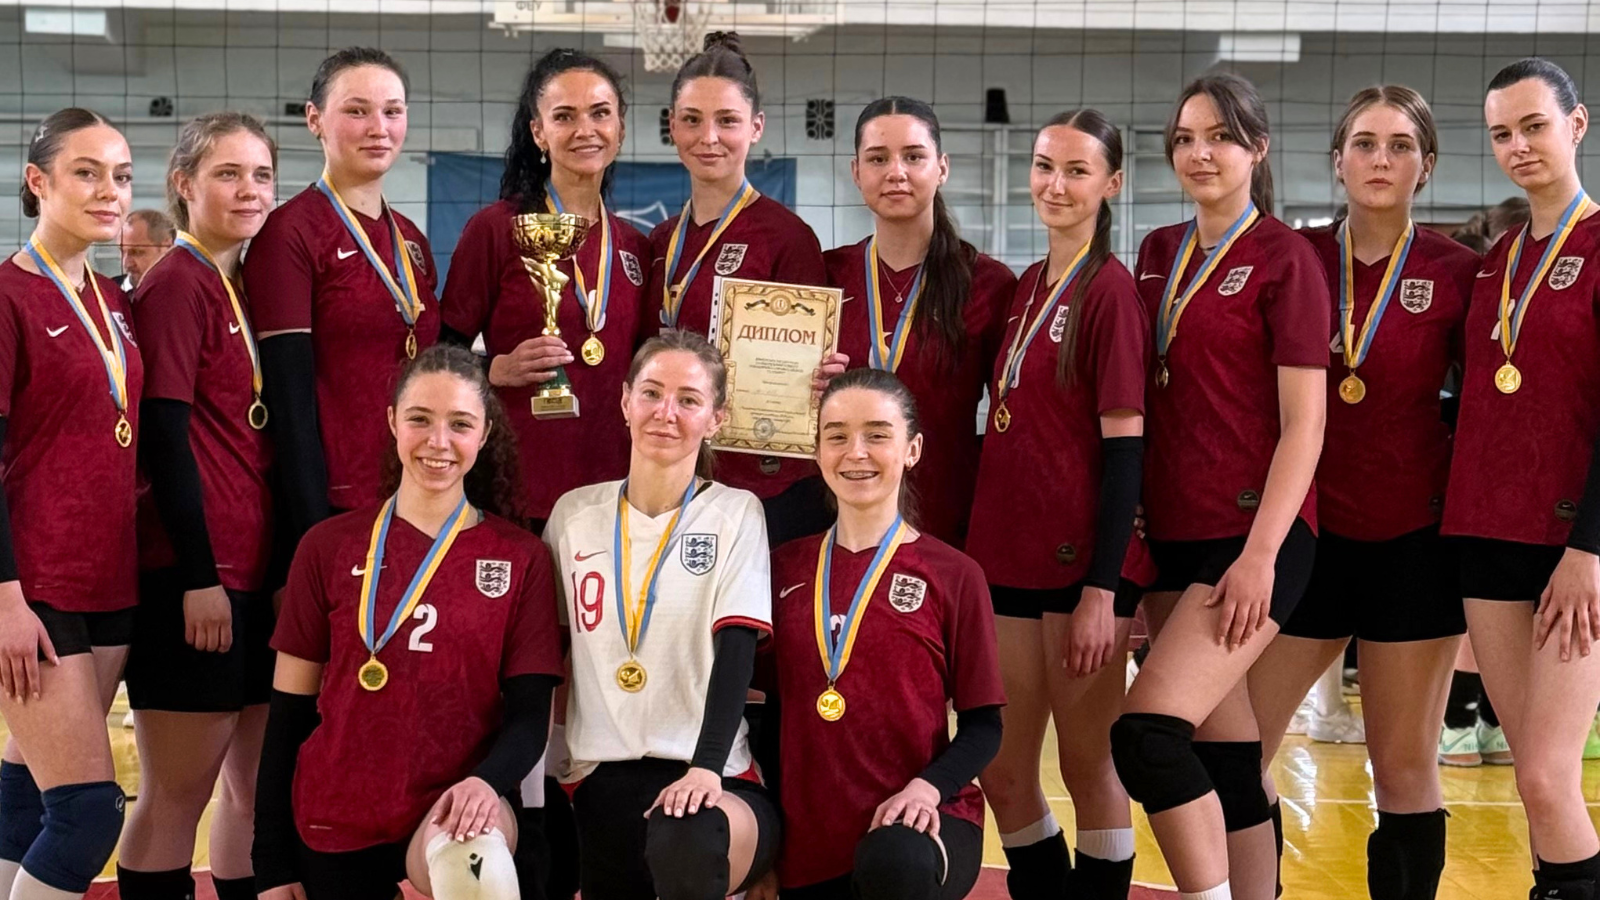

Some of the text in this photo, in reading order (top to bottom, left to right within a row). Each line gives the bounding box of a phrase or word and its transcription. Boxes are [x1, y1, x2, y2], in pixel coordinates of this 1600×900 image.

[737, 324, 817, 346] ДИПЛОМ
[571, 571, 606, 634] 19
[408, 603, 438, 652] 2
